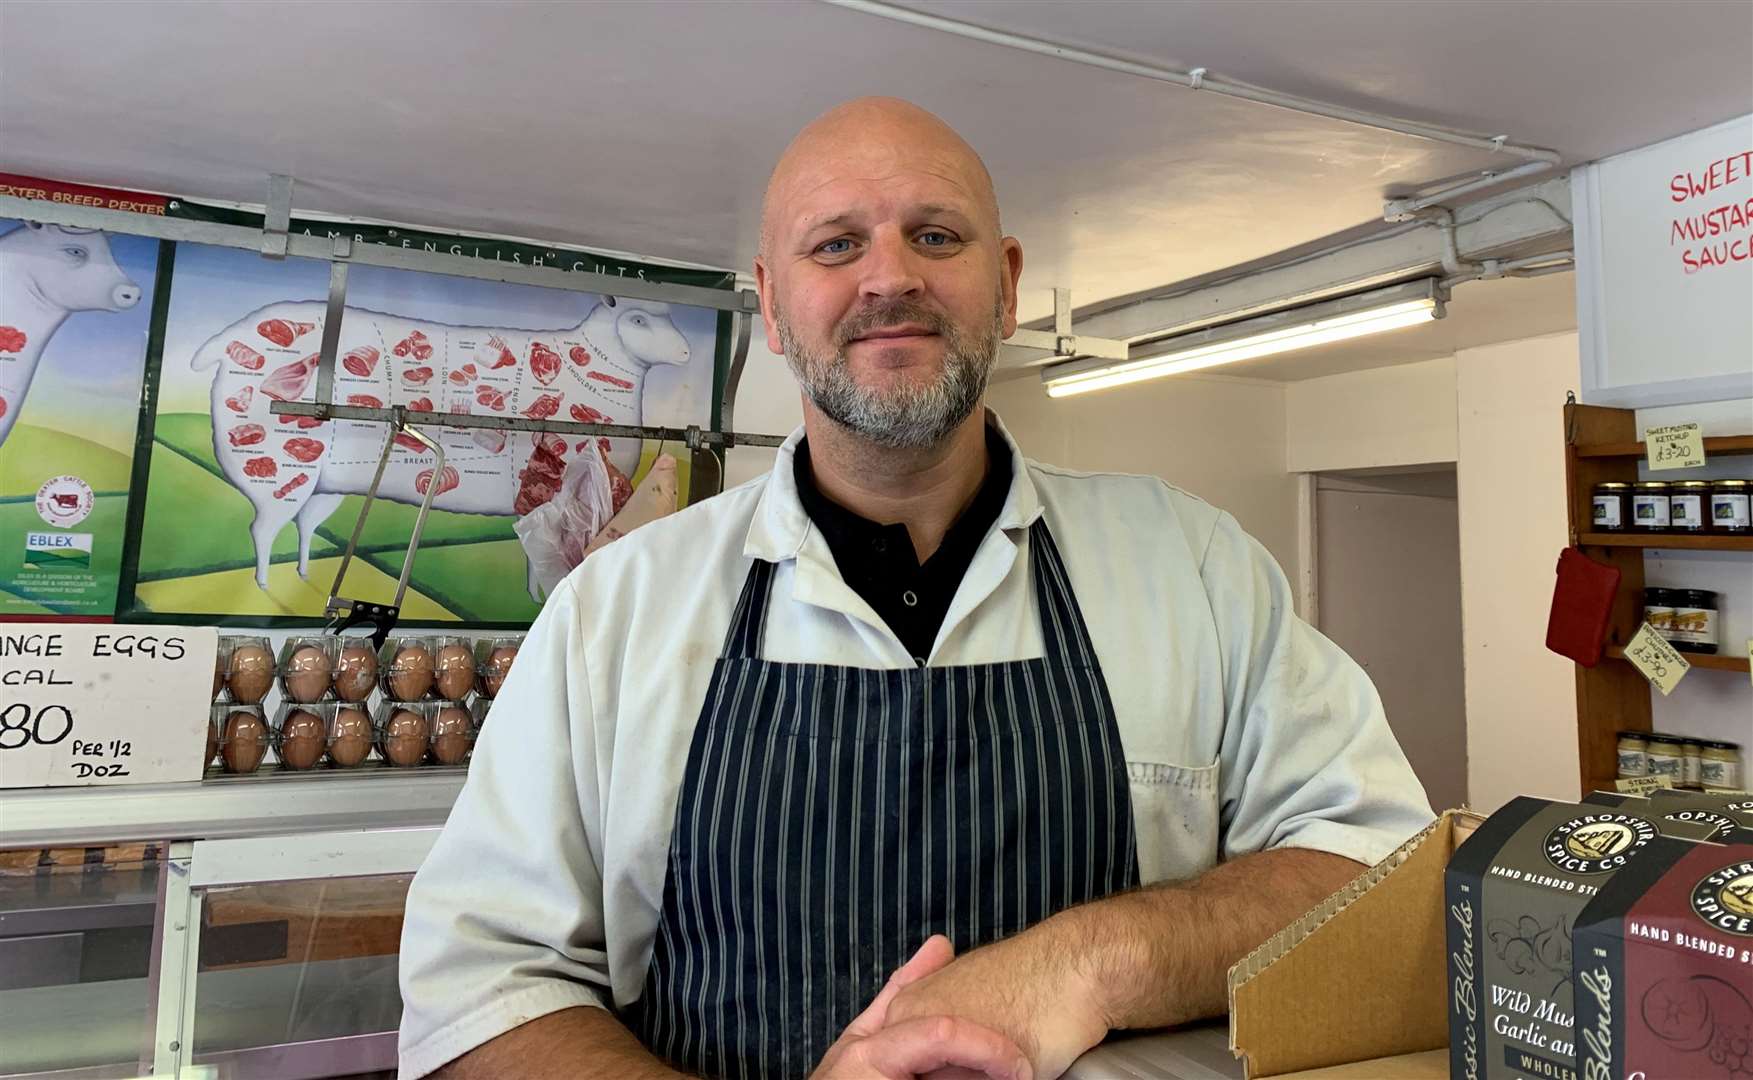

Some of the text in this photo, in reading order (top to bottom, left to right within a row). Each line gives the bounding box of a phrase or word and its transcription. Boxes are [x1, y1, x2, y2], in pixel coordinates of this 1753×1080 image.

[1670, 150, 1753, 202] SWEET
[52, 191, 103, 207] BREED
[108, 199, 166, 216] DEXTER
[573, 261, 645, 280] CUTS
[567, 364, 597, 393] SHOULDER
[1655, 431, 1690, 443] KETCHUP
[29, 534, 73, 547] EBLEX
[0, 634, 186, 660] NGE EGGS
[2, 669, 73, 685] CAL
[0, 703, 73, 750] 80
[72, 739, 104, 756] PER
[71, 762, 130, 778] DOZ
[1559, 814, 1654, 847] SHROPSHIRE
[1548, 844, 1589, 872] SPICE
[1490, 865, 1521, 879] HAND
[1524, 872, 1575, 891] BLENDED
[1697, 897, 1751, 931] SPICE
[1630, 922, 1753, 965] HAND BLENDED S
[1451, 899, 1478, 1022] Blends
[1491, 984, 1531, 1014] Wild
[1494, 1014, 1577, 1057] Garlic an
